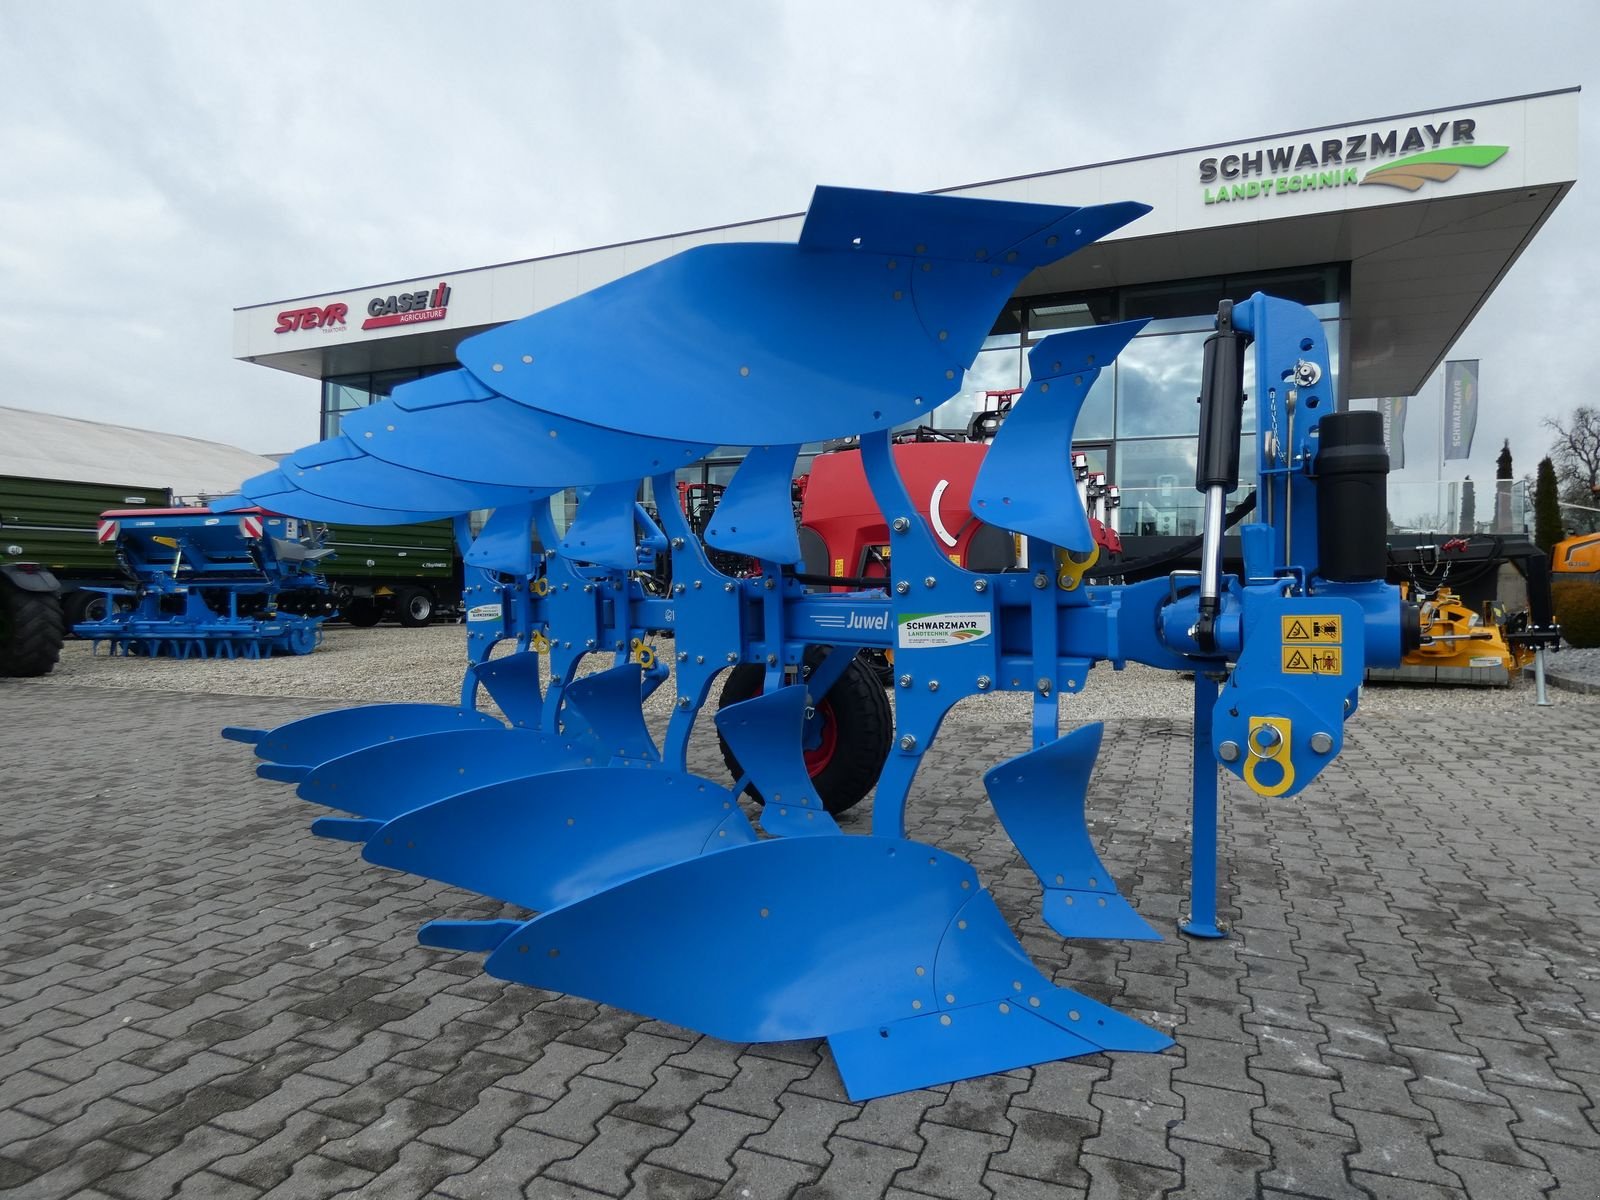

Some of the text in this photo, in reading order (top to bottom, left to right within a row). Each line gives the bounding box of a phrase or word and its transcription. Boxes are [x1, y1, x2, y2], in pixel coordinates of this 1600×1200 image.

[1199, 118, 1477, 184] SCHWARZMAYR
[1204, 166, 1359, 205] LANDTECHNIK
[274, 303, 348, 333] STEYR
[368, 291, 429, 317] CASE
[400, 308, 443, 323] AGRICULTURE
[1452, 379, 1462, 447] SCHWARZMAYR
[846, 611, 889, 630] Juwel
[906, 621, 977, 630] SCHWARZMAYR
